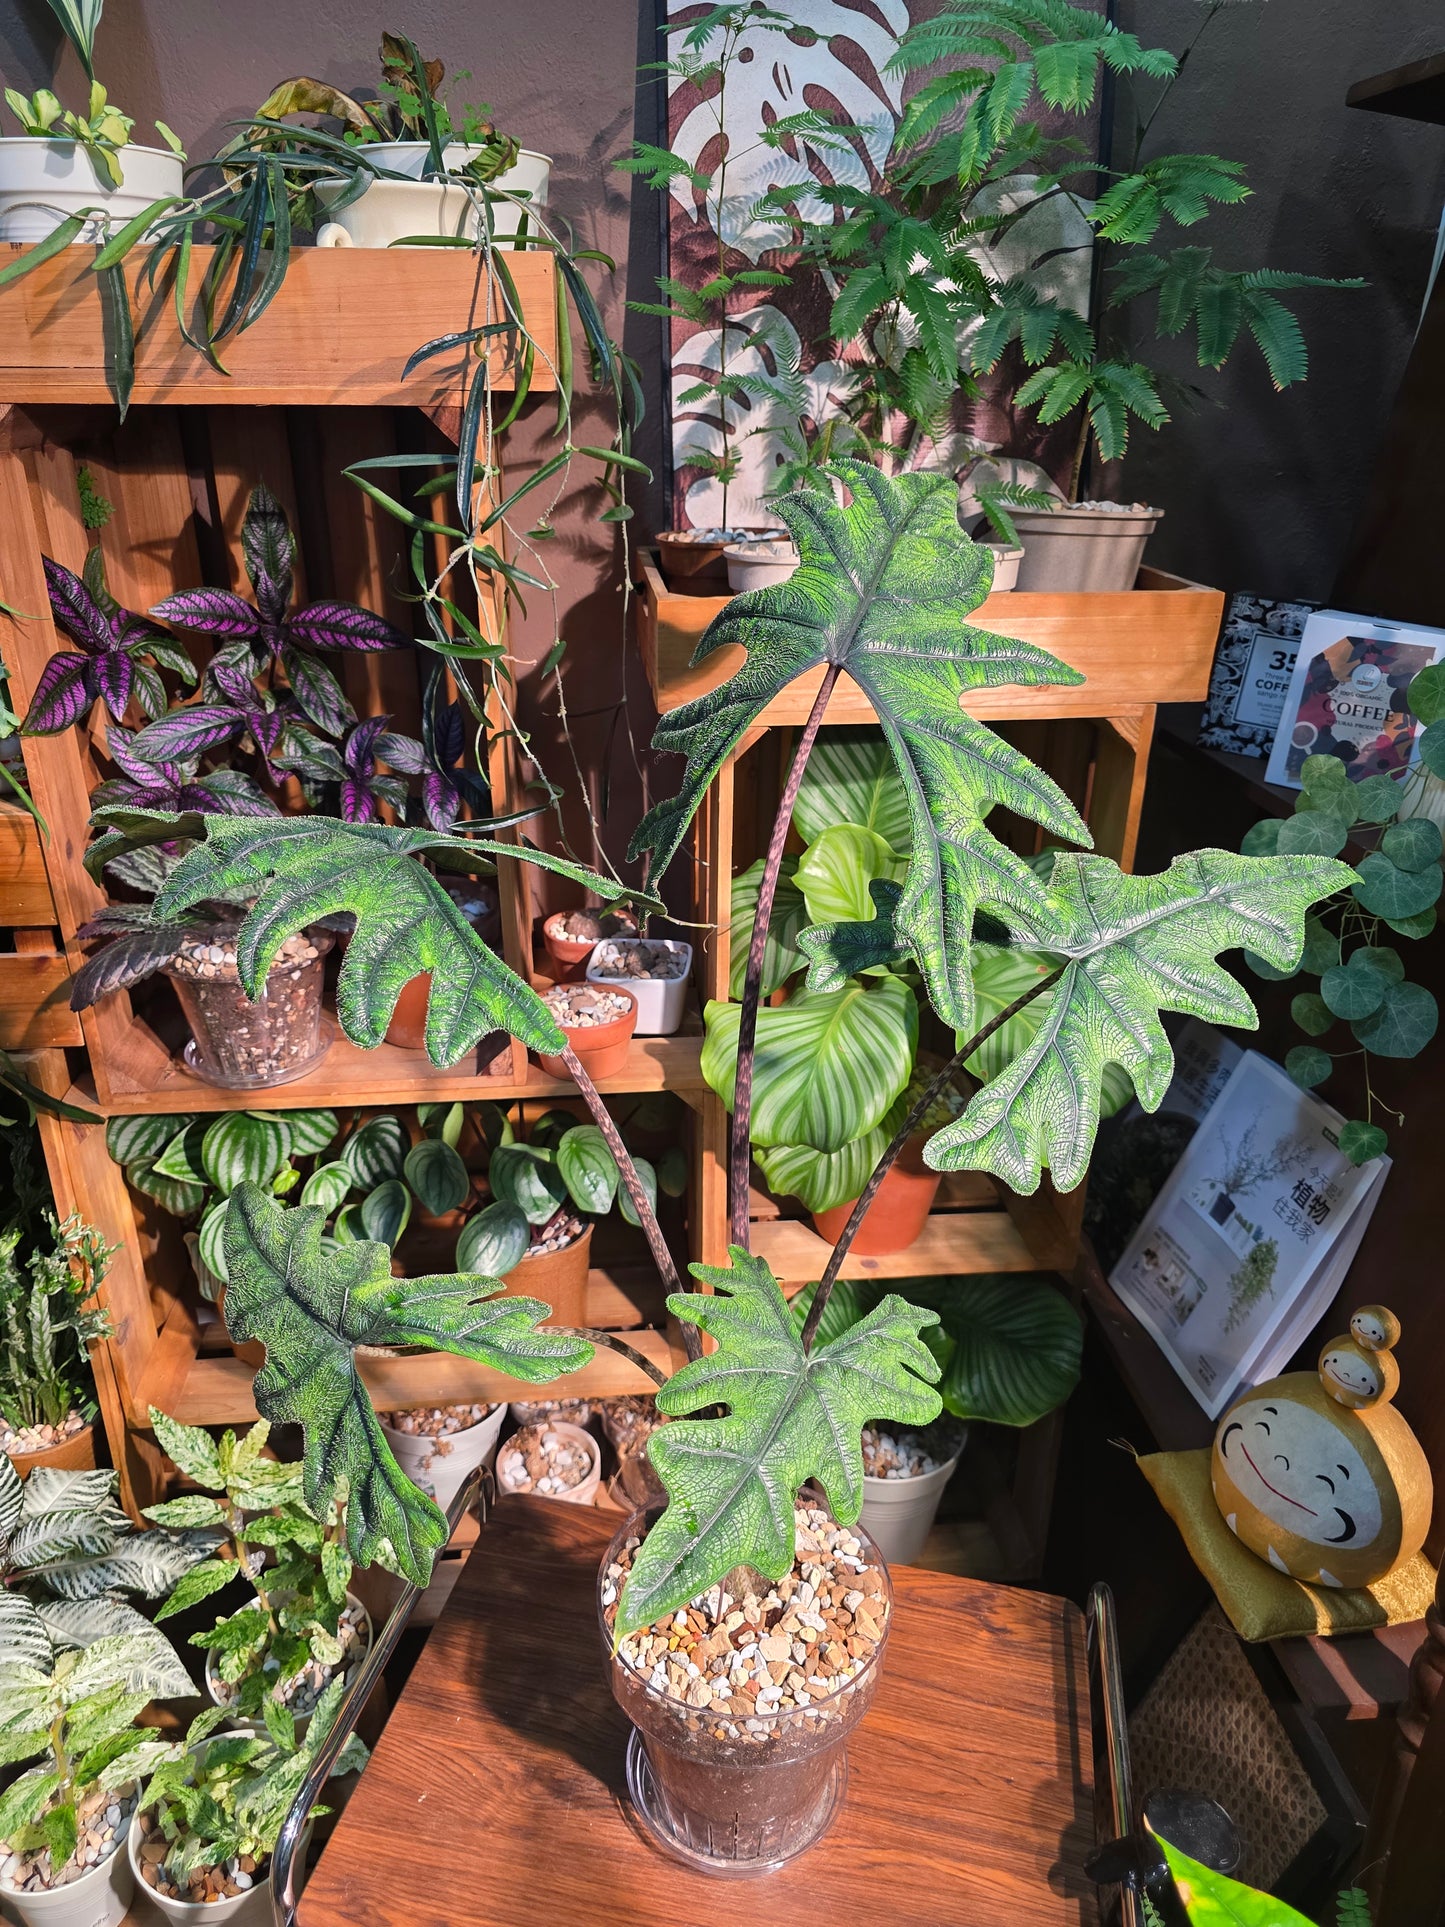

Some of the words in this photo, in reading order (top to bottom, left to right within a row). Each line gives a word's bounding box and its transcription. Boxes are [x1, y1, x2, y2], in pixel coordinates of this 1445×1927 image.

[1265, 671, 1285, 681] Three
[1355, 693, 1384, 701] ORGANIC
[1322, 698, 1394, 722] COFFEE
[1355, 722, 1384, 731] PRODUCT
[1290, 1177, 1331, 1226] 植物
[1272, 1196, 1316, 1245] 住我家
